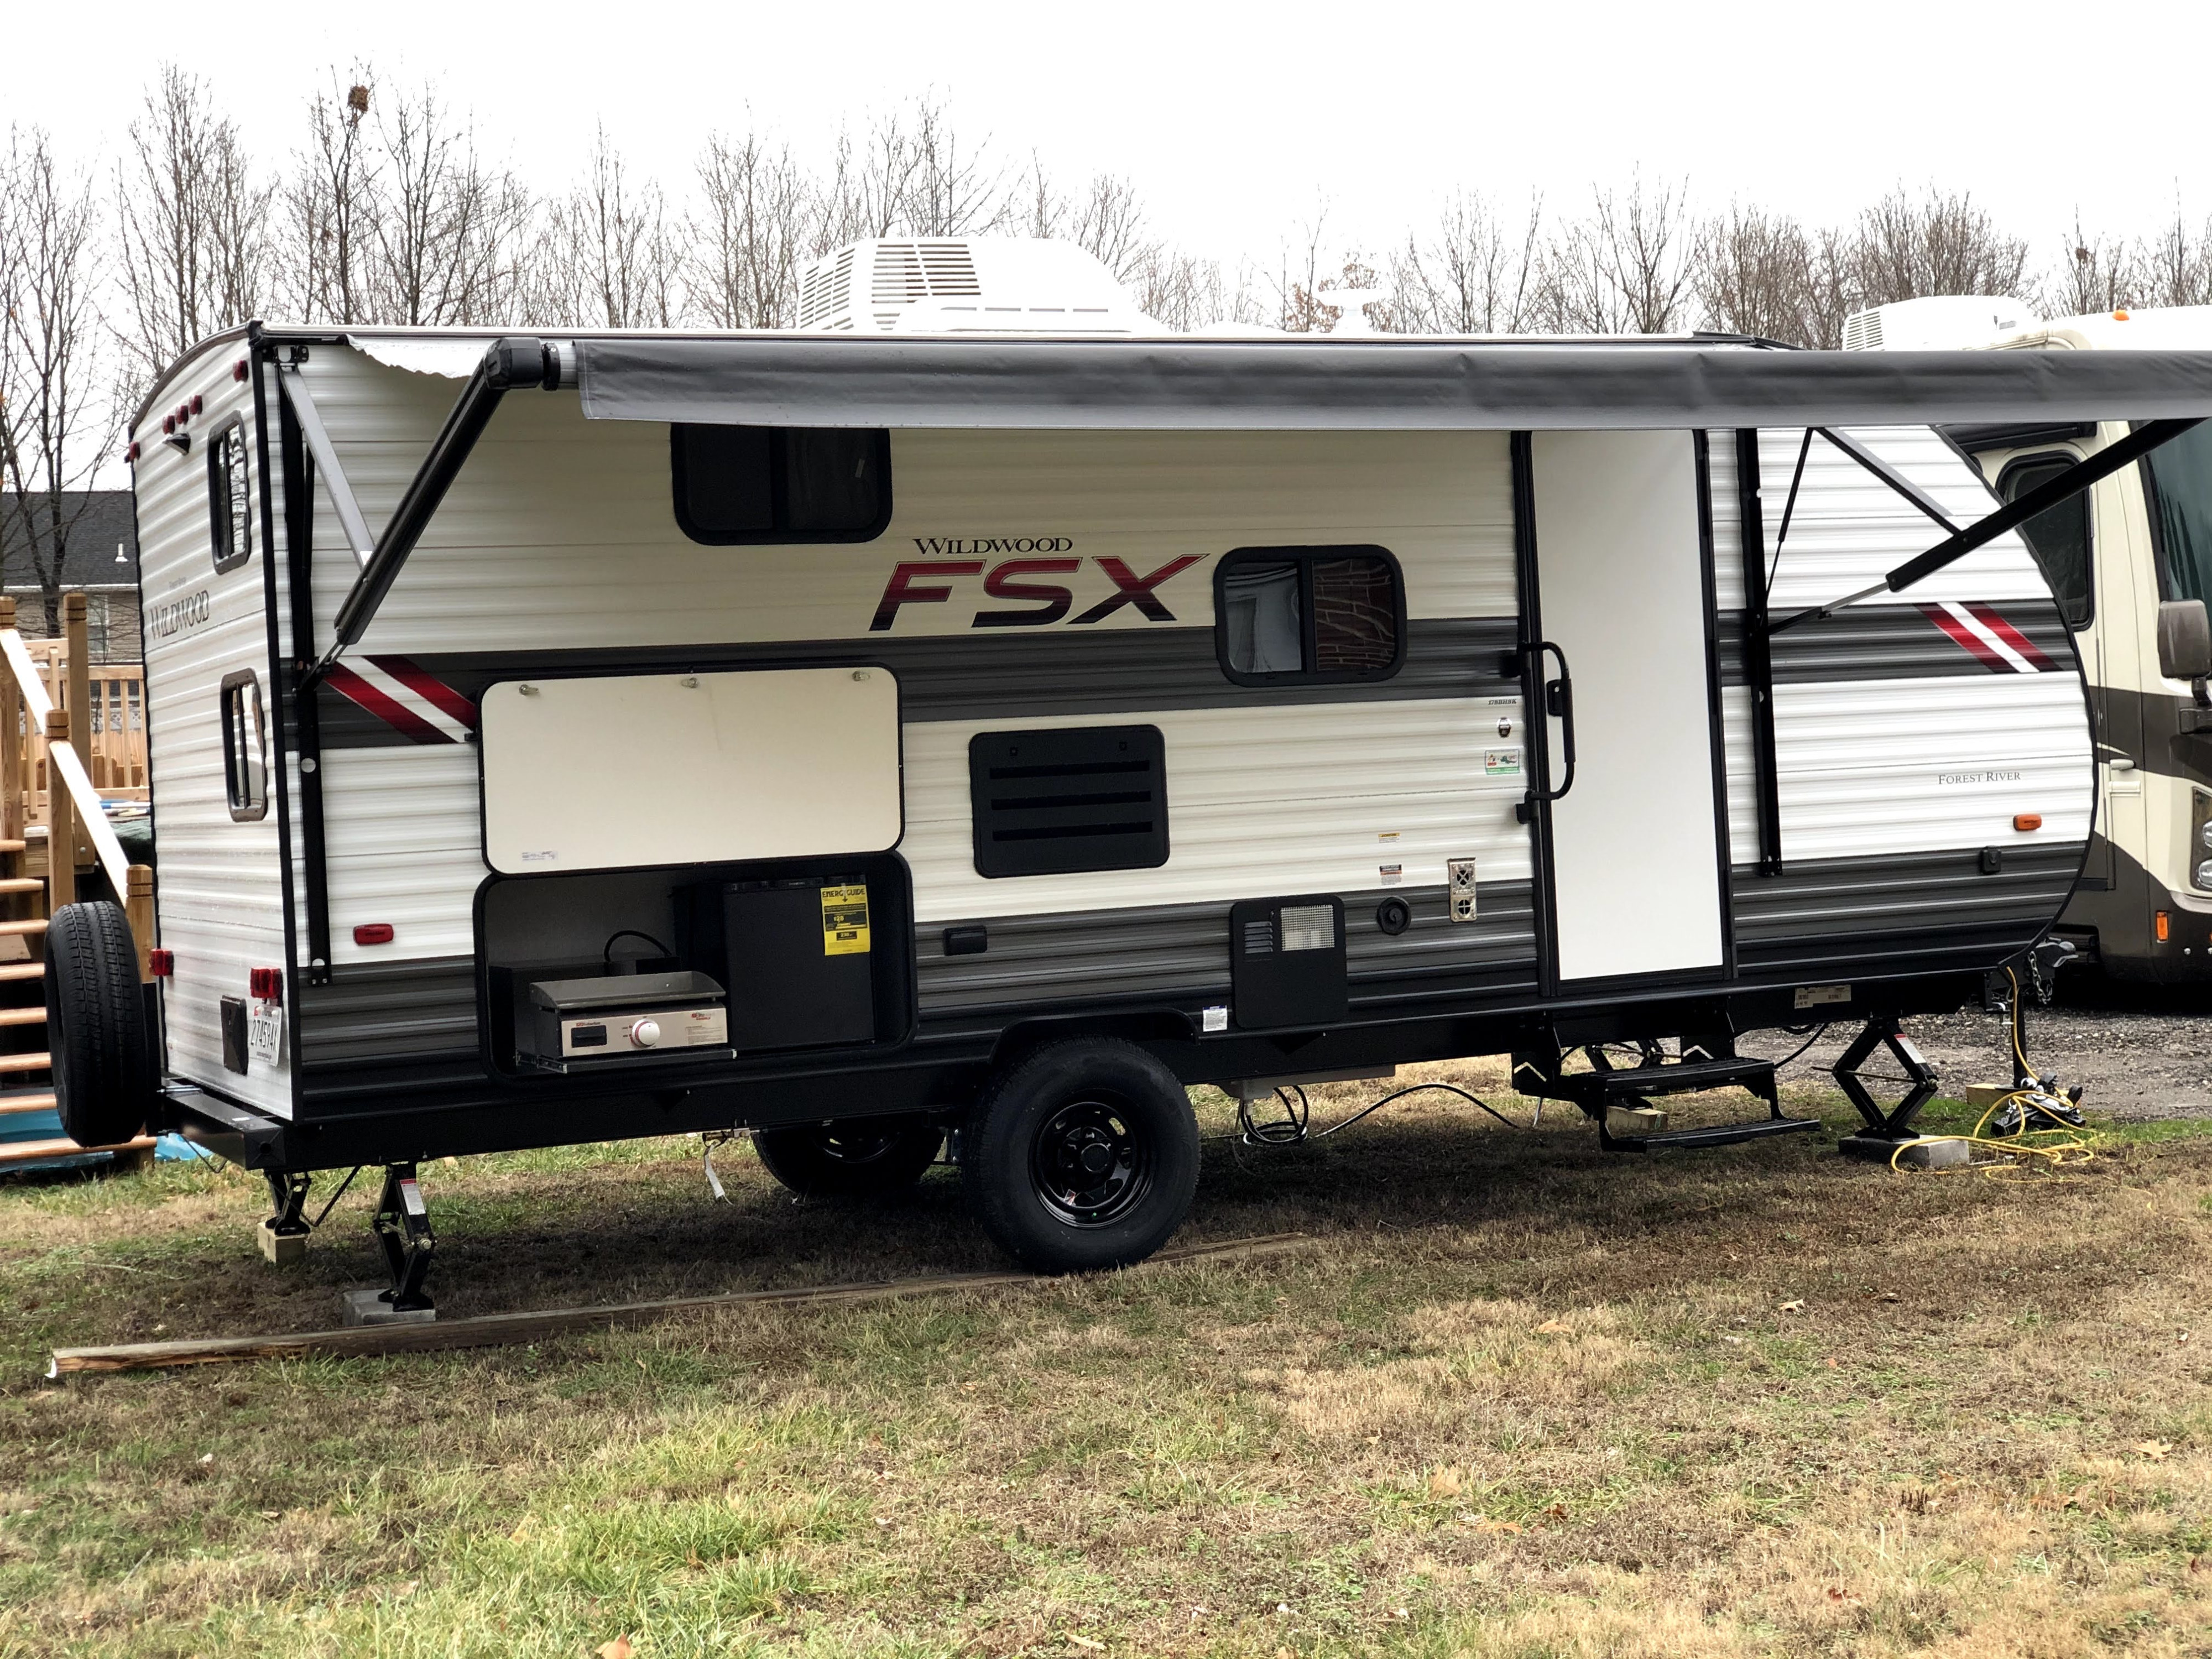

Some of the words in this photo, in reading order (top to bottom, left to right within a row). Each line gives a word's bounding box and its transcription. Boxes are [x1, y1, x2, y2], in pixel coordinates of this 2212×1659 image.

[912, 538, 1073, 554] WILDWOOD
[868, 553, 1211, 632] FSX
[1938, 774, 1983, 785] FOREST
[1986, 771, 2021, 781] RIVER
